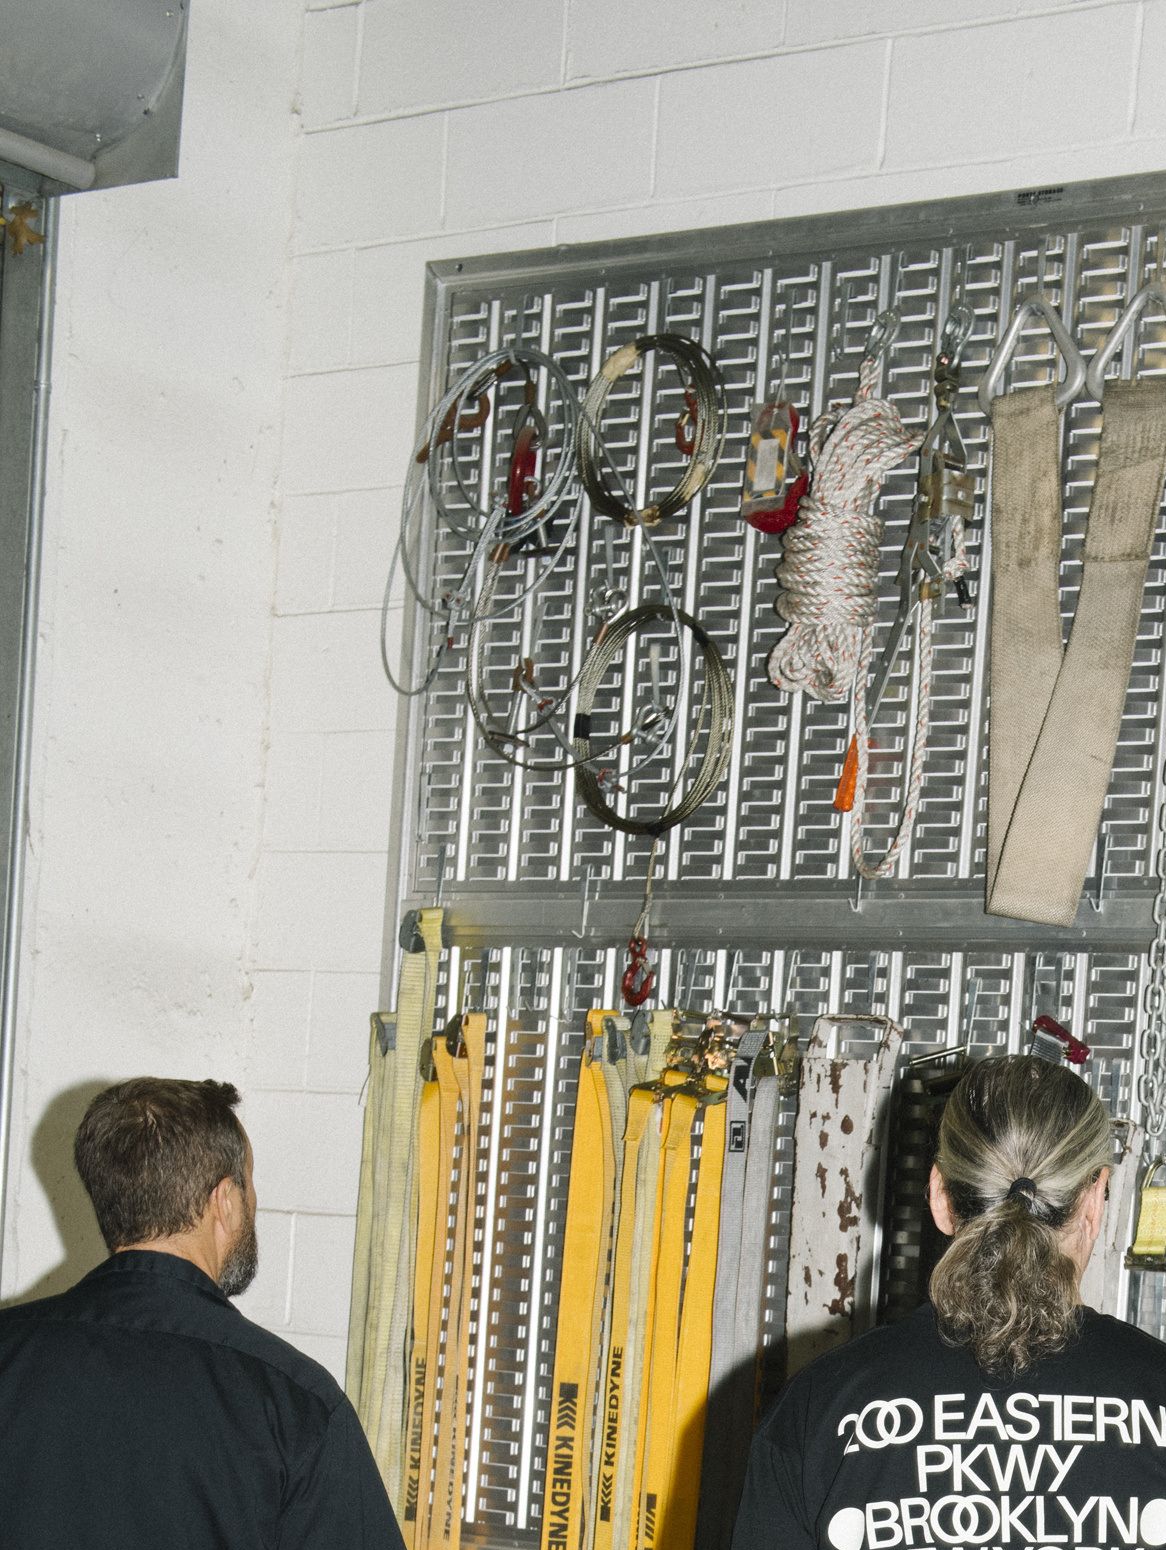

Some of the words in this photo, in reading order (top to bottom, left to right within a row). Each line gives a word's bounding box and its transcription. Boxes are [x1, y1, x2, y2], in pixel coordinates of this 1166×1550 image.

[606, 1346, 623, 1467] KINEDYNE
[838, 1397, 924, 1456] 200
[916, 1444, 1083, 1493] PKWY
[865, 1494, 1139, 1550] BROOKLYN
